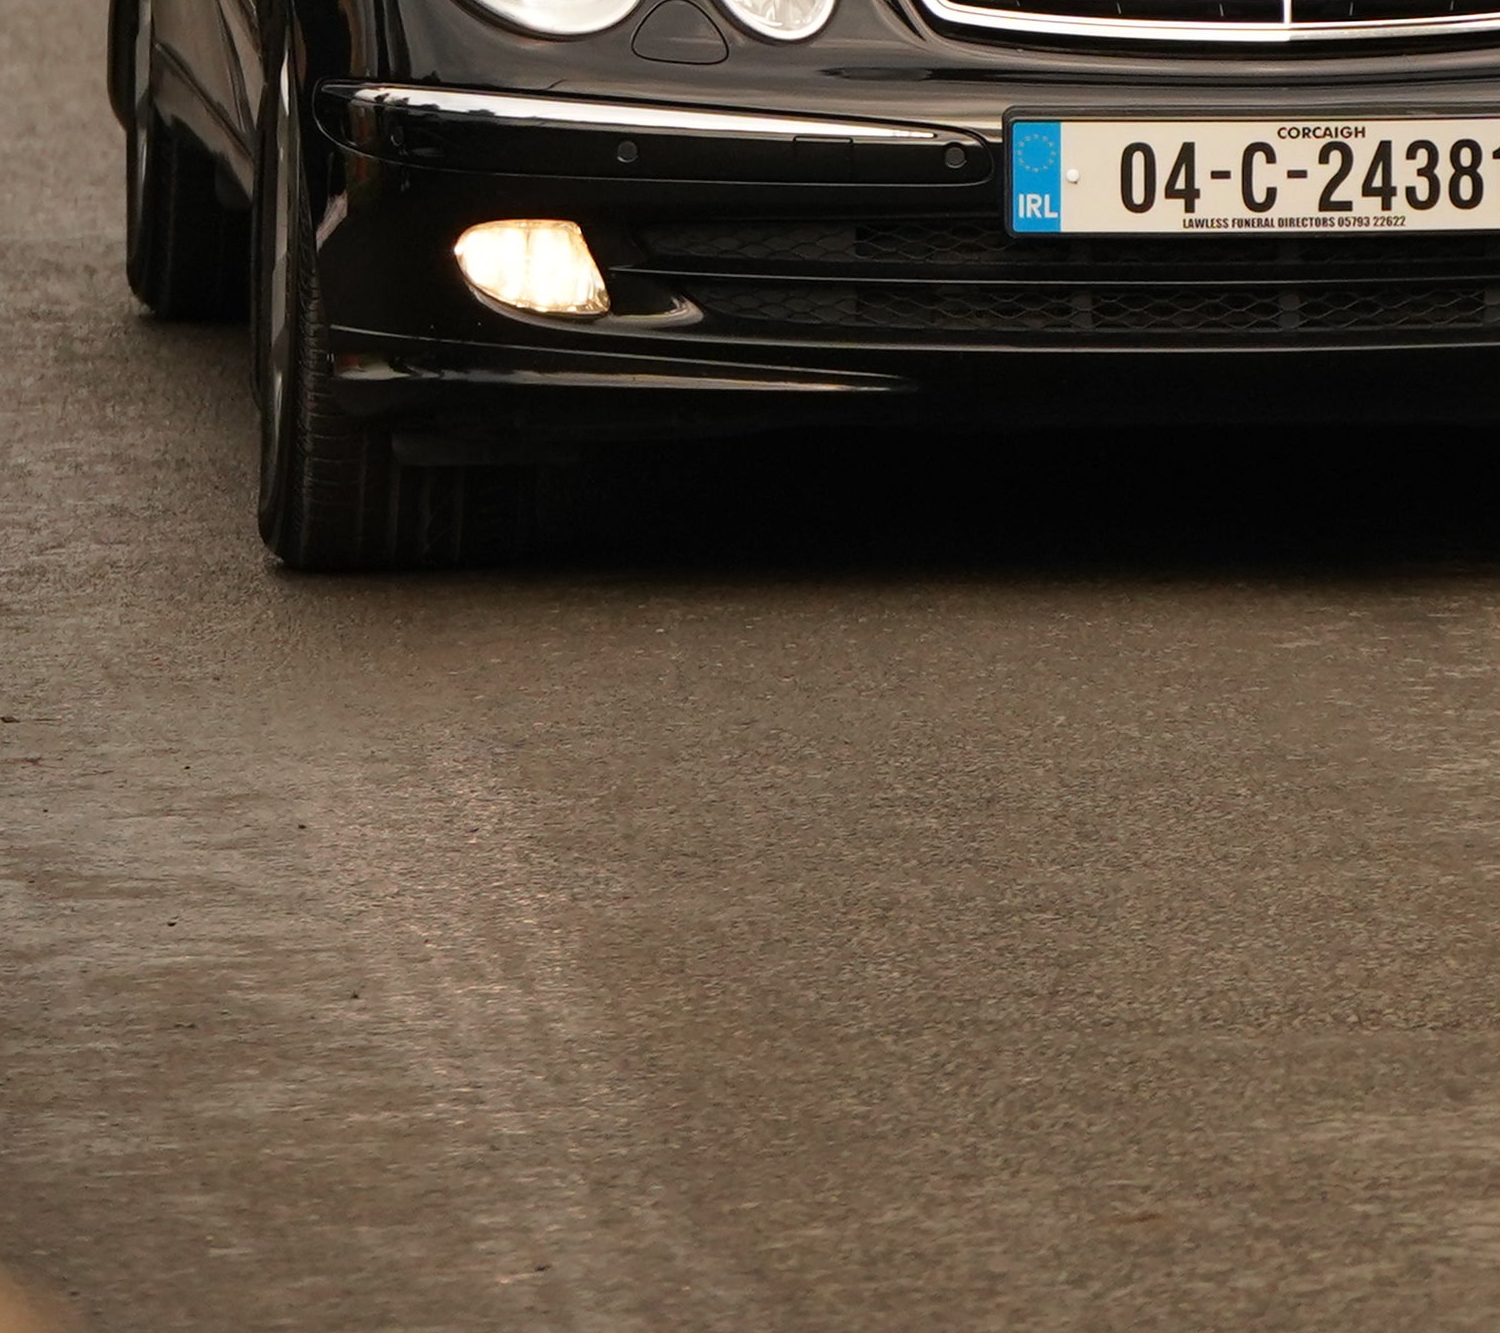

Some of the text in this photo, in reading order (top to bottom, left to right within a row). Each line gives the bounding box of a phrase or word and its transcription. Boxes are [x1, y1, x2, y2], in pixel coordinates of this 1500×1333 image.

[1277, 126, 1366, 139] CORCAIGH
[1018, 194, 1059, 219] IRL
[1183, 215, 1407, 229] LAWLESS FUNERAL DIRECTORS 05793 22622
